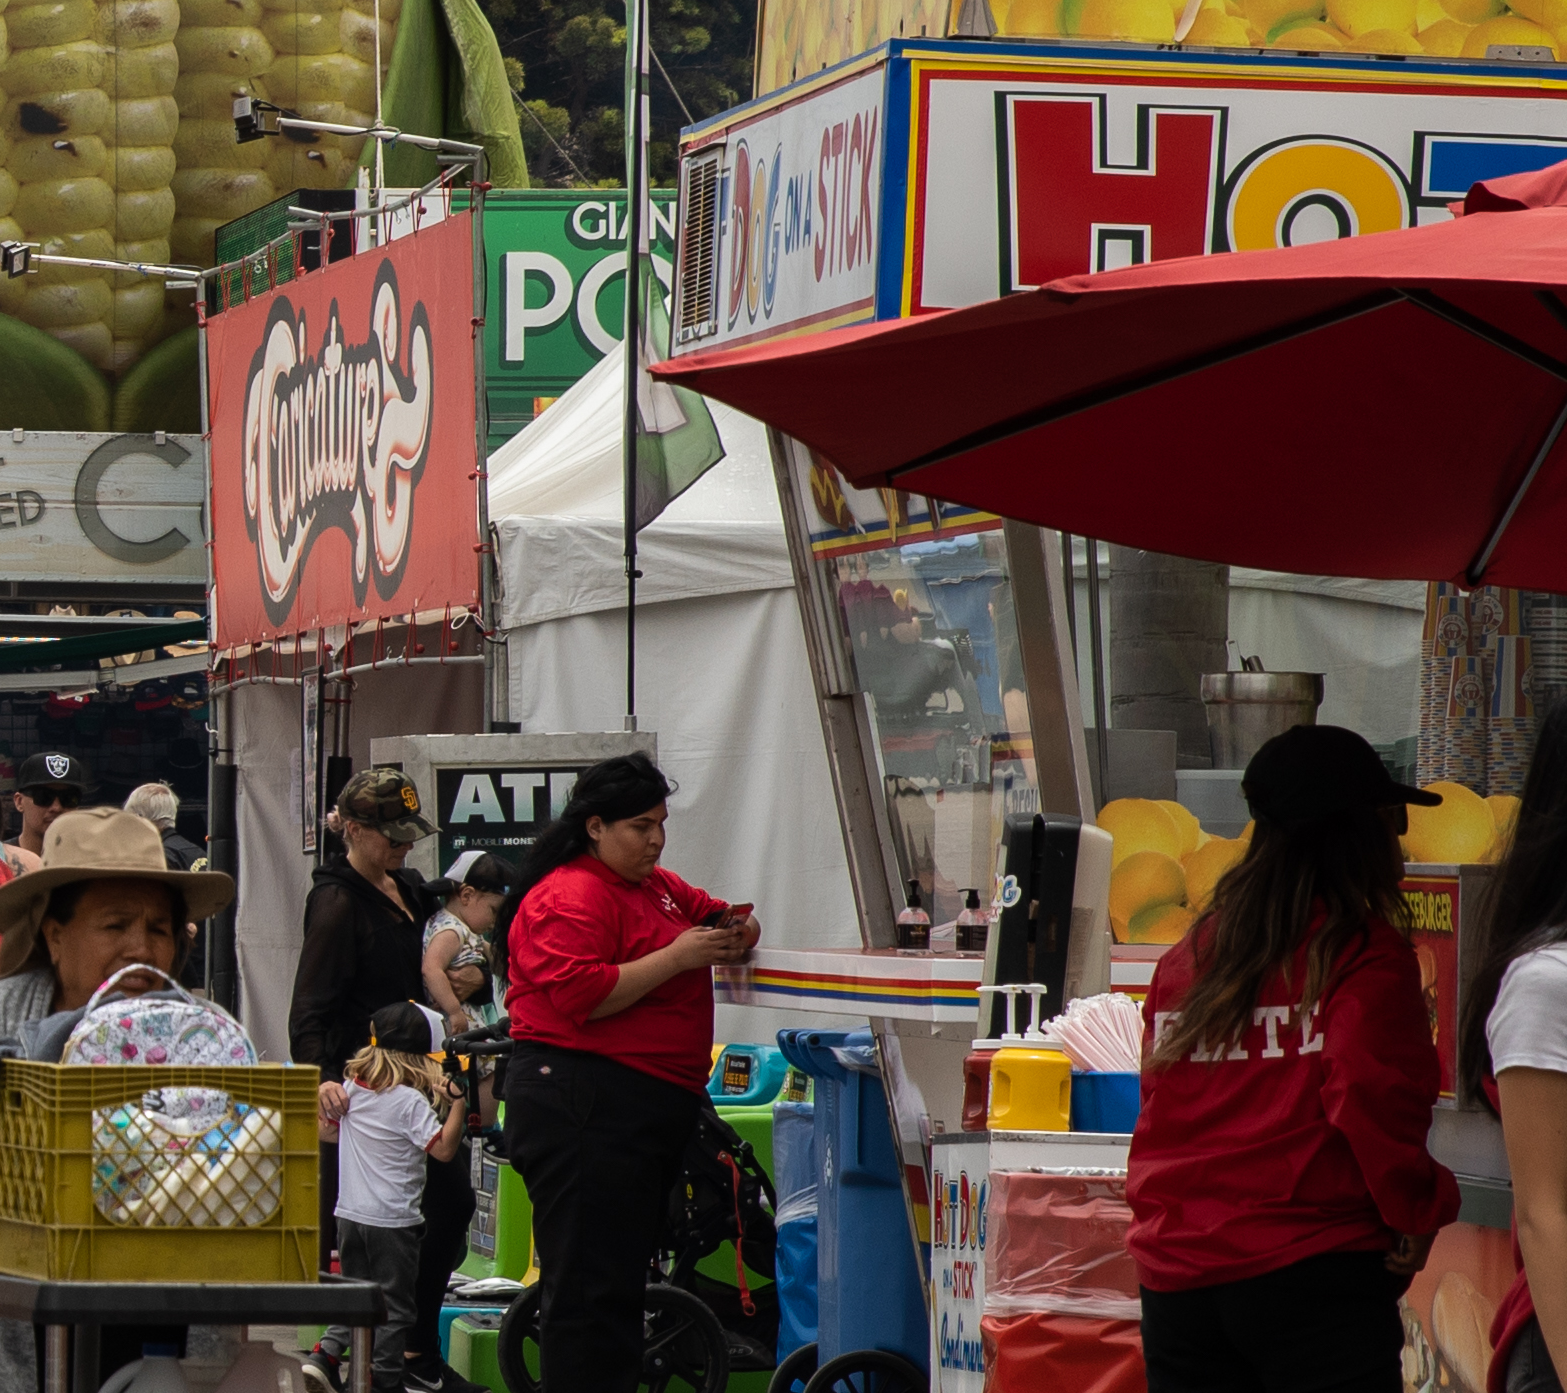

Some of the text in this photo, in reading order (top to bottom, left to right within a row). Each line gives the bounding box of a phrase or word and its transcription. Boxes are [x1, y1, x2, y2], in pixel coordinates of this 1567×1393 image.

[727, 104, 879, 333] DOG ON A STICK
[401, 786, 418, 810] SD
[933, 1169, 988, 1252] HOT DOG
[952, 1259, 975, 1300] STICK
